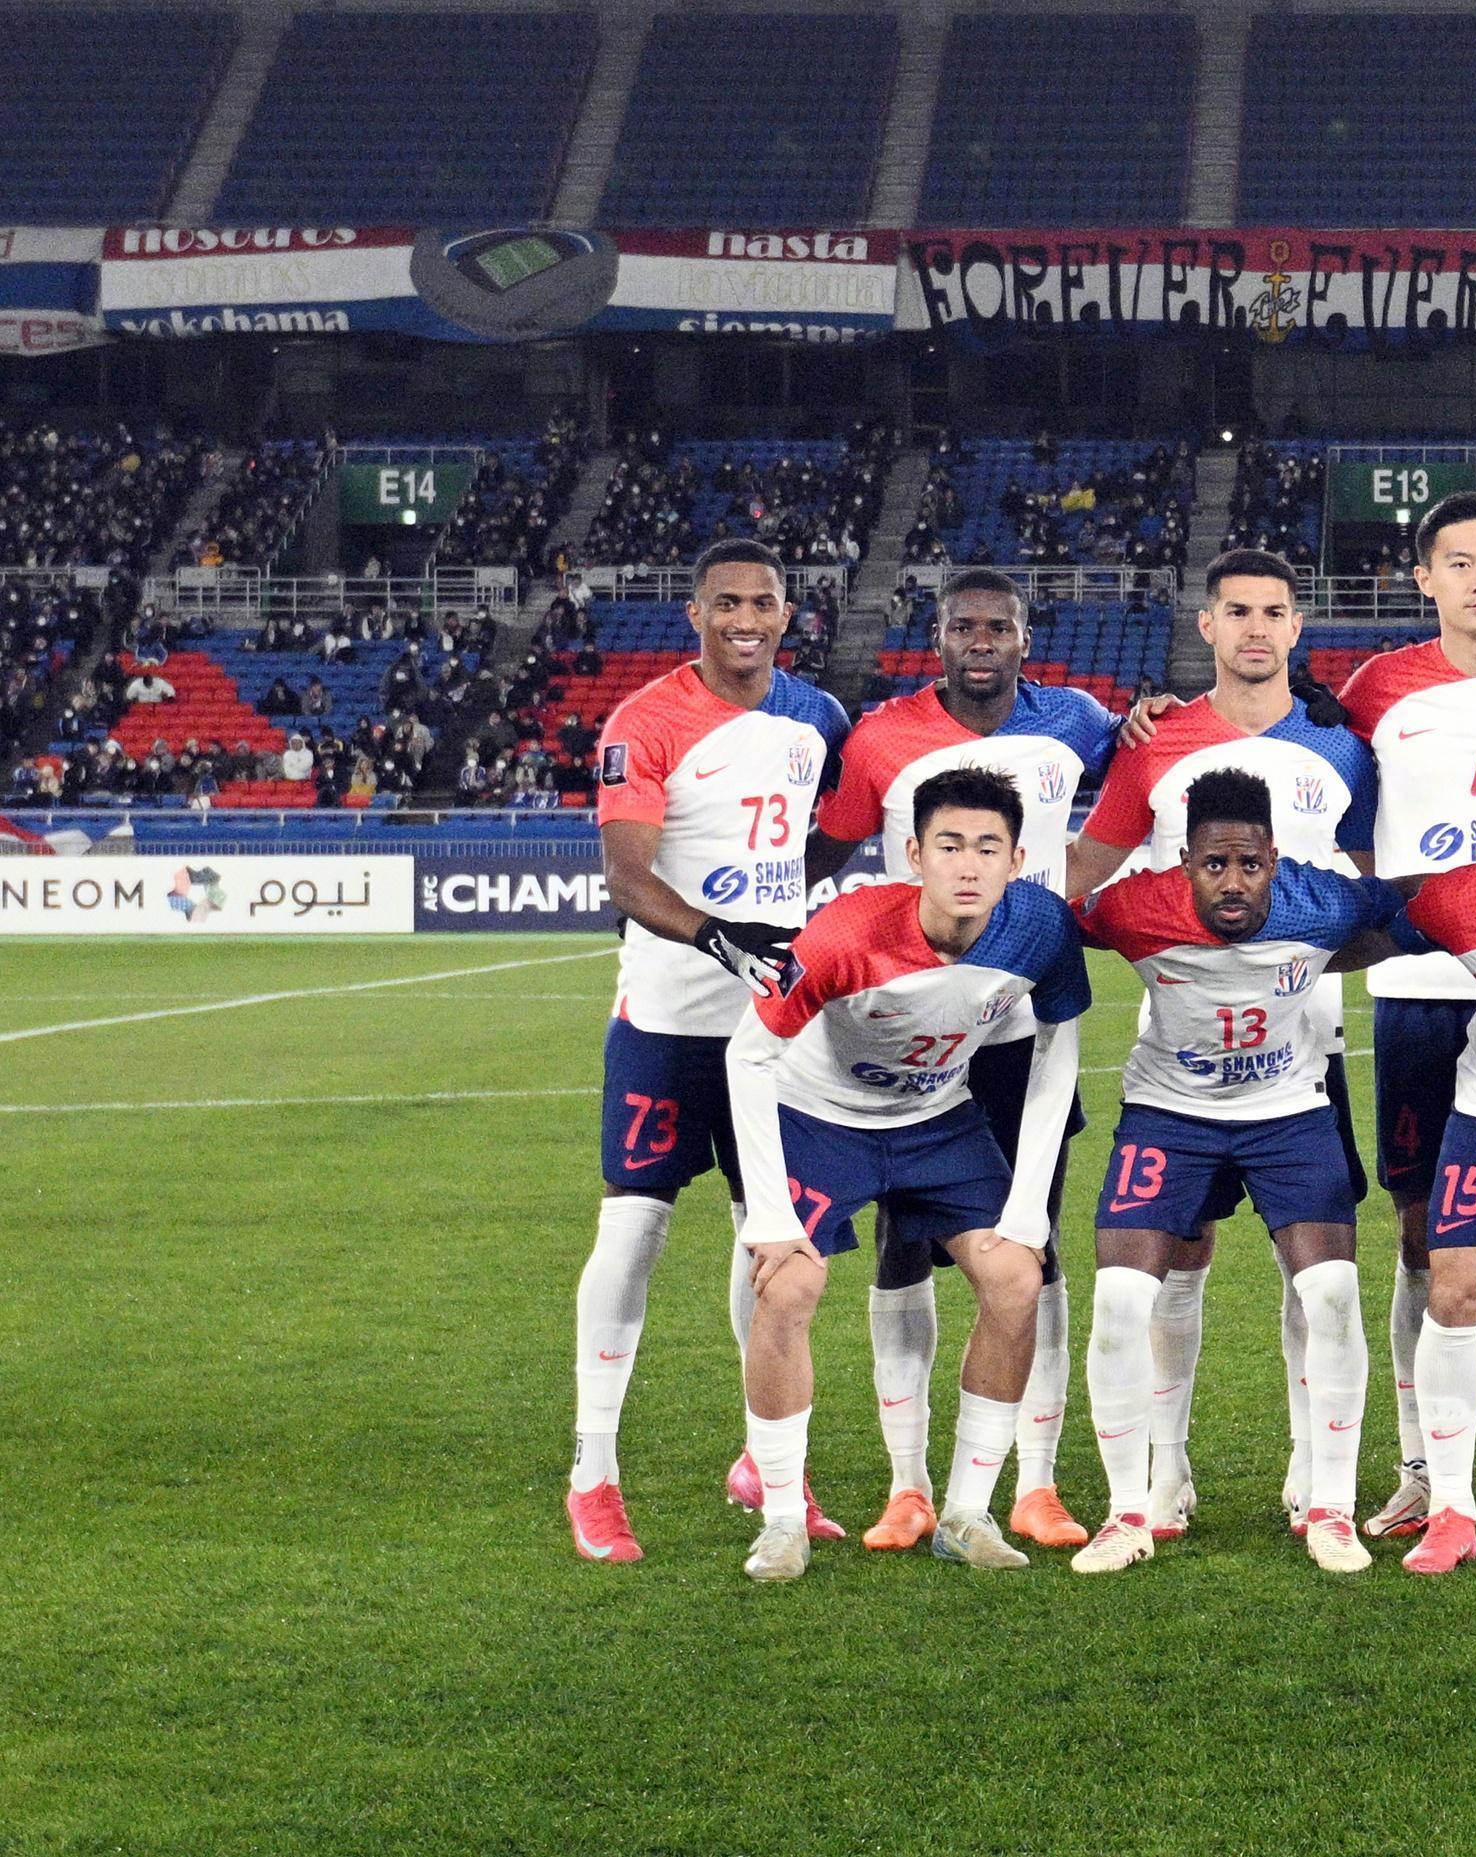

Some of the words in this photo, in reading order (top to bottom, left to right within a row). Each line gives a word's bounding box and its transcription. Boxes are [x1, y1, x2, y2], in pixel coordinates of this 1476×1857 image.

[380, 470, 437, 504] E14
[1373, 469, 1430, 503] E13
[741, 794, 790, 850] 73
[2, 879, 145, 910] NEOM
[250, 871, 371, 917] نيوم
[424, 875, 438, 912] AFC
[1216, 1008, 1268, 1050] 13
[900, 1032, 968, 1067] 27
[625, 1093, 680, 1152] 73
[1117, 1144, 1168, 1199] 13
